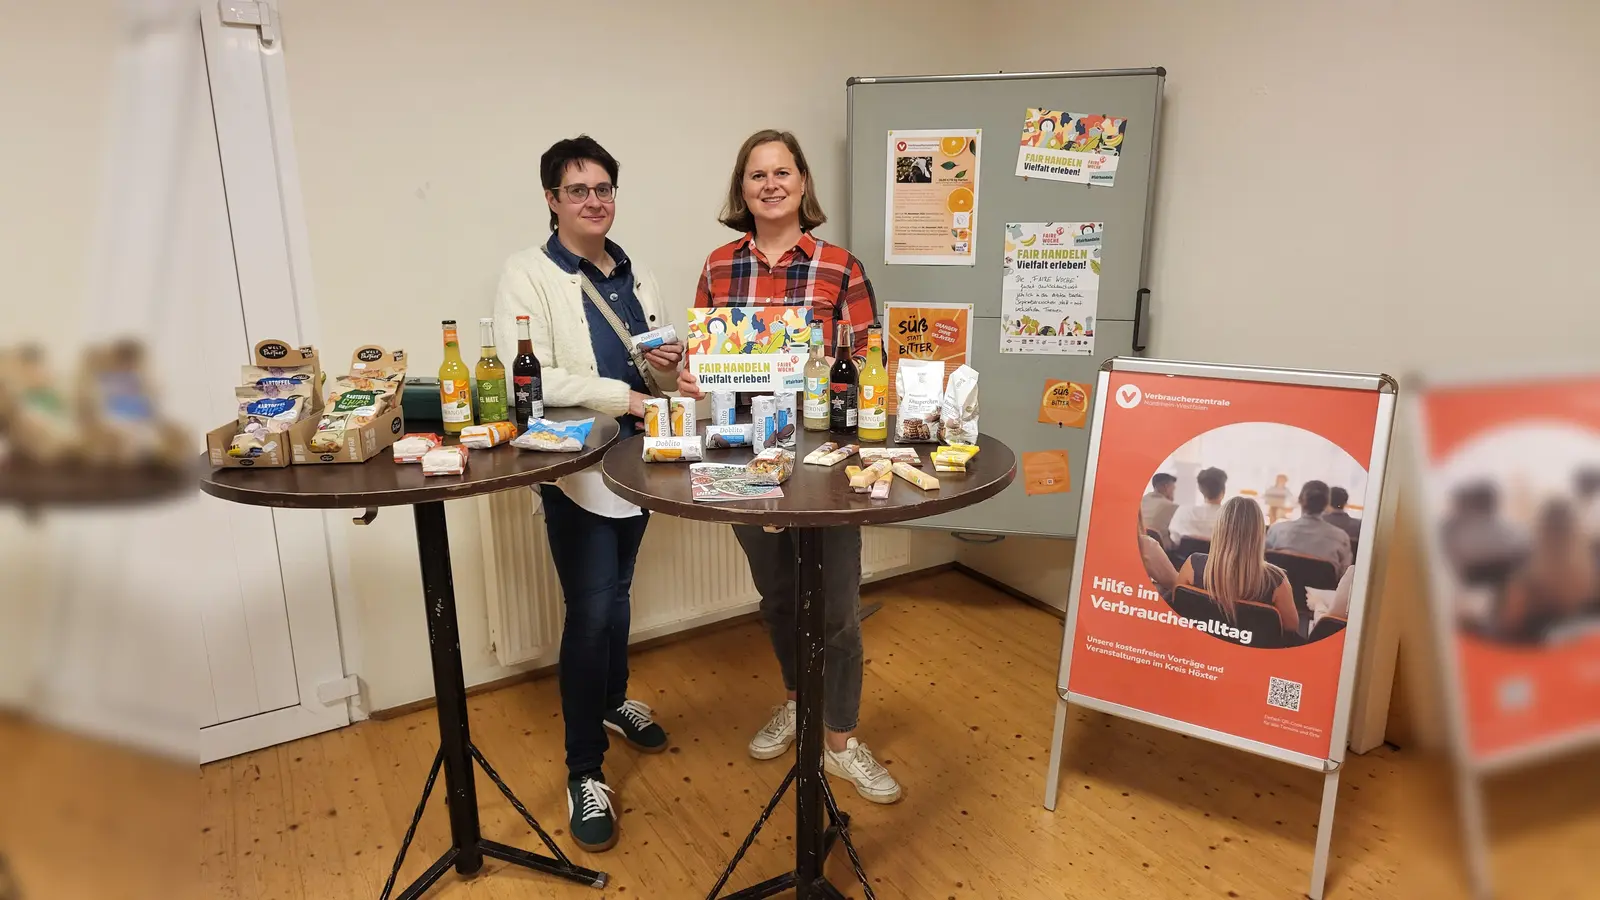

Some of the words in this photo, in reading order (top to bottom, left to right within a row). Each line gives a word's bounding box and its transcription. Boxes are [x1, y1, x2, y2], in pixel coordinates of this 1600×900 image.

[1025, 153, 1044, 163] FAIR
[1044, 155, 1083, 168] HANDELN
[1024, 163, 1050, 173] Vielfalt
[1050, 167, 1081, 176] erleben!
[1017, 249, 1040, 259] FAIR
[1041, 249, 1088, 259] HANDELN
[1017, 260, 1049, 269] Vielfalt
[1049, 260, 1087, 269] erleben!
[641, 332, 660, 341] Doblito
[899, 342, 933, 354] BITTER
[699, 362, 722, 373] FAIR
[723, 362, 771, 373] HANDELN
[699, 374, 732, 384] Vielfalt
[733, 374, 771, 384] erleben!
[341, 398, 370, 406] CHIPS
[1144, 392, 1231, 406] Verbraucherzentrale
[1144, 400, 1209, 411] Nordrhein-Westfalen
[1093, 576, 1134, 596] Hilfe
[1137, 584, 1160, 602] im
[1090, 595, 1253, 644] Verbraucheralltag
[1086, 635, 1114, 648] Unsere
[1115, 640, 1166, 660] kostenfreien
[1167, 653, 1205, 670] Vorträge
[1206, 664, 1224, 674] und
[1085, 643, 1151, 666] Veranstaltungen
[1152, 659, 1163, 668] im
[1164, 662, 1186, 674] Kreis
[1188, 667, 1218, 681] Höxter
[1281, 718, 1303, 728] QR-Code
